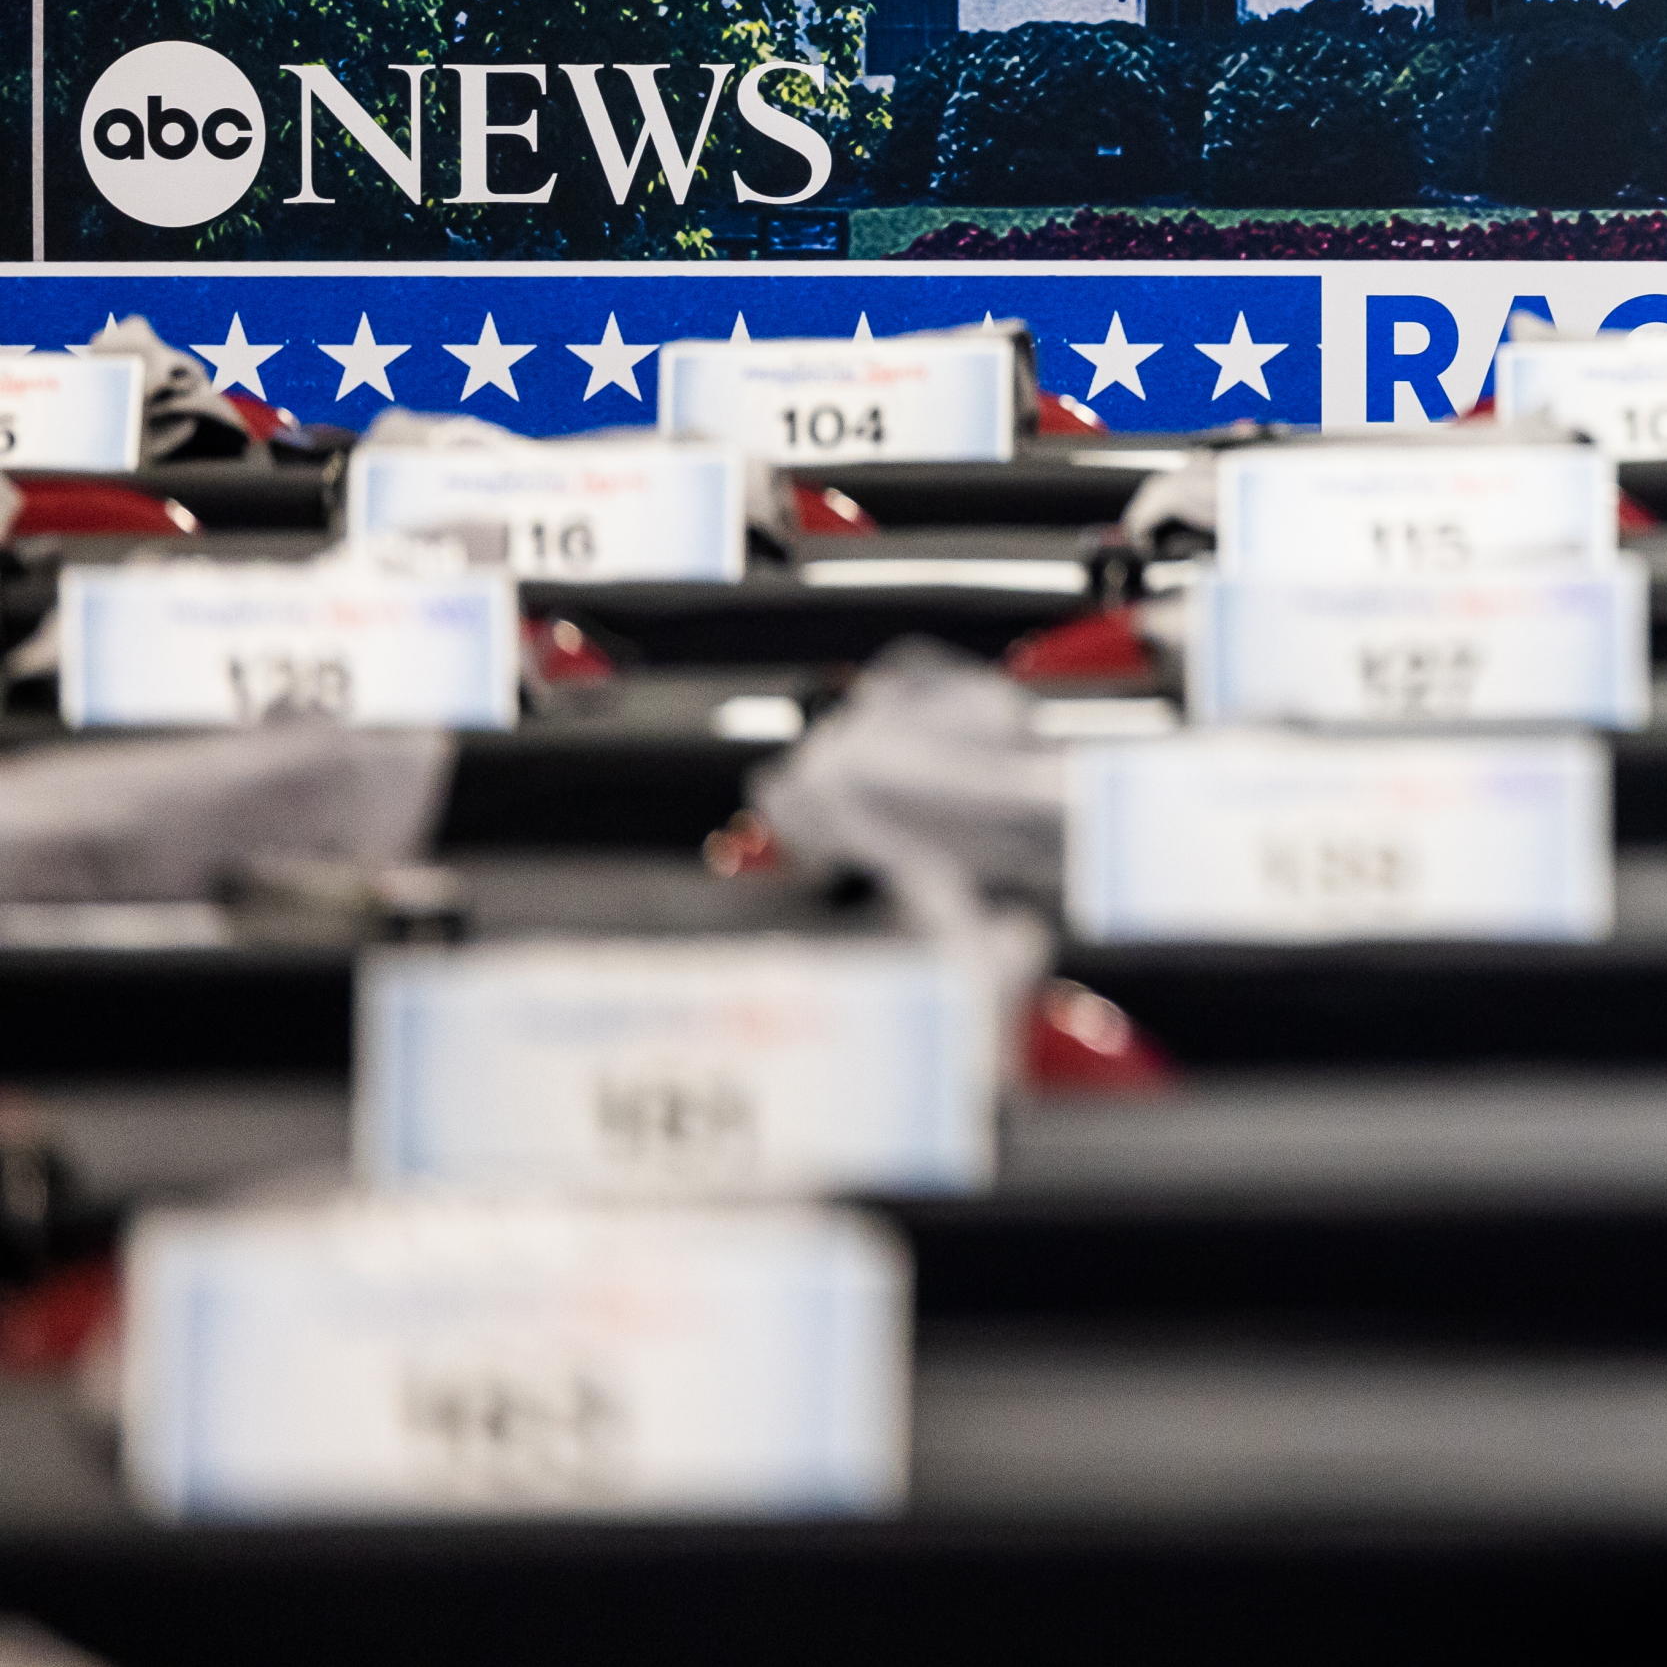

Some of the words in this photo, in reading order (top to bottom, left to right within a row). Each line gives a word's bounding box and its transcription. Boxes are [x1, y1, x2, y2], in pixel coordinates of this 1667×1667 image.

[93, 95, 254, 161] abc
[279, 60, 833, 206] NEWS
[780, 404, 886, 448] 104
